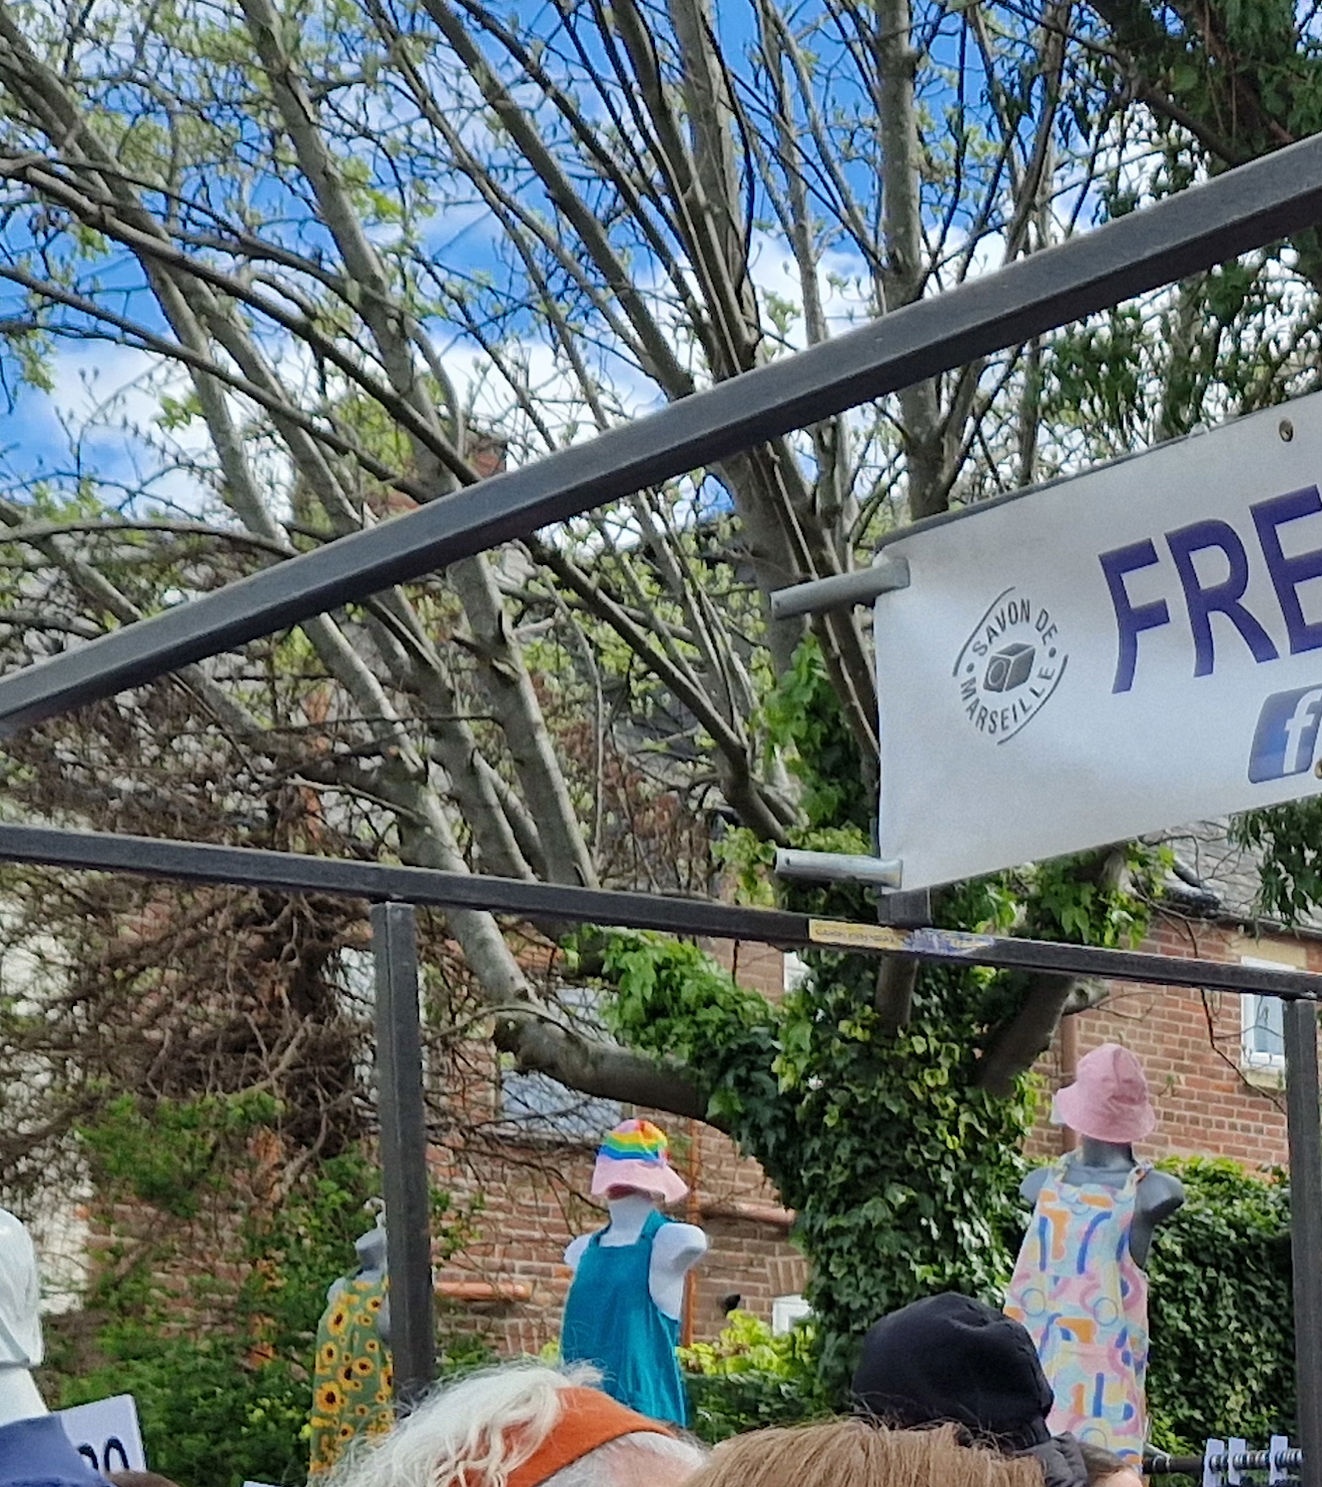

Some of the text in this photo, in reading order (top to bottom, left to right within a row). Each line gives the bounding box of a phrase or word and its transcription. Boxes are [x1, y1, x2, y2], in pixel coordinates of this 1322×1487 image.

[972, 598, 1059, 657] SAVON DE
[960, 666, 1056, 734] MARSEILLE
